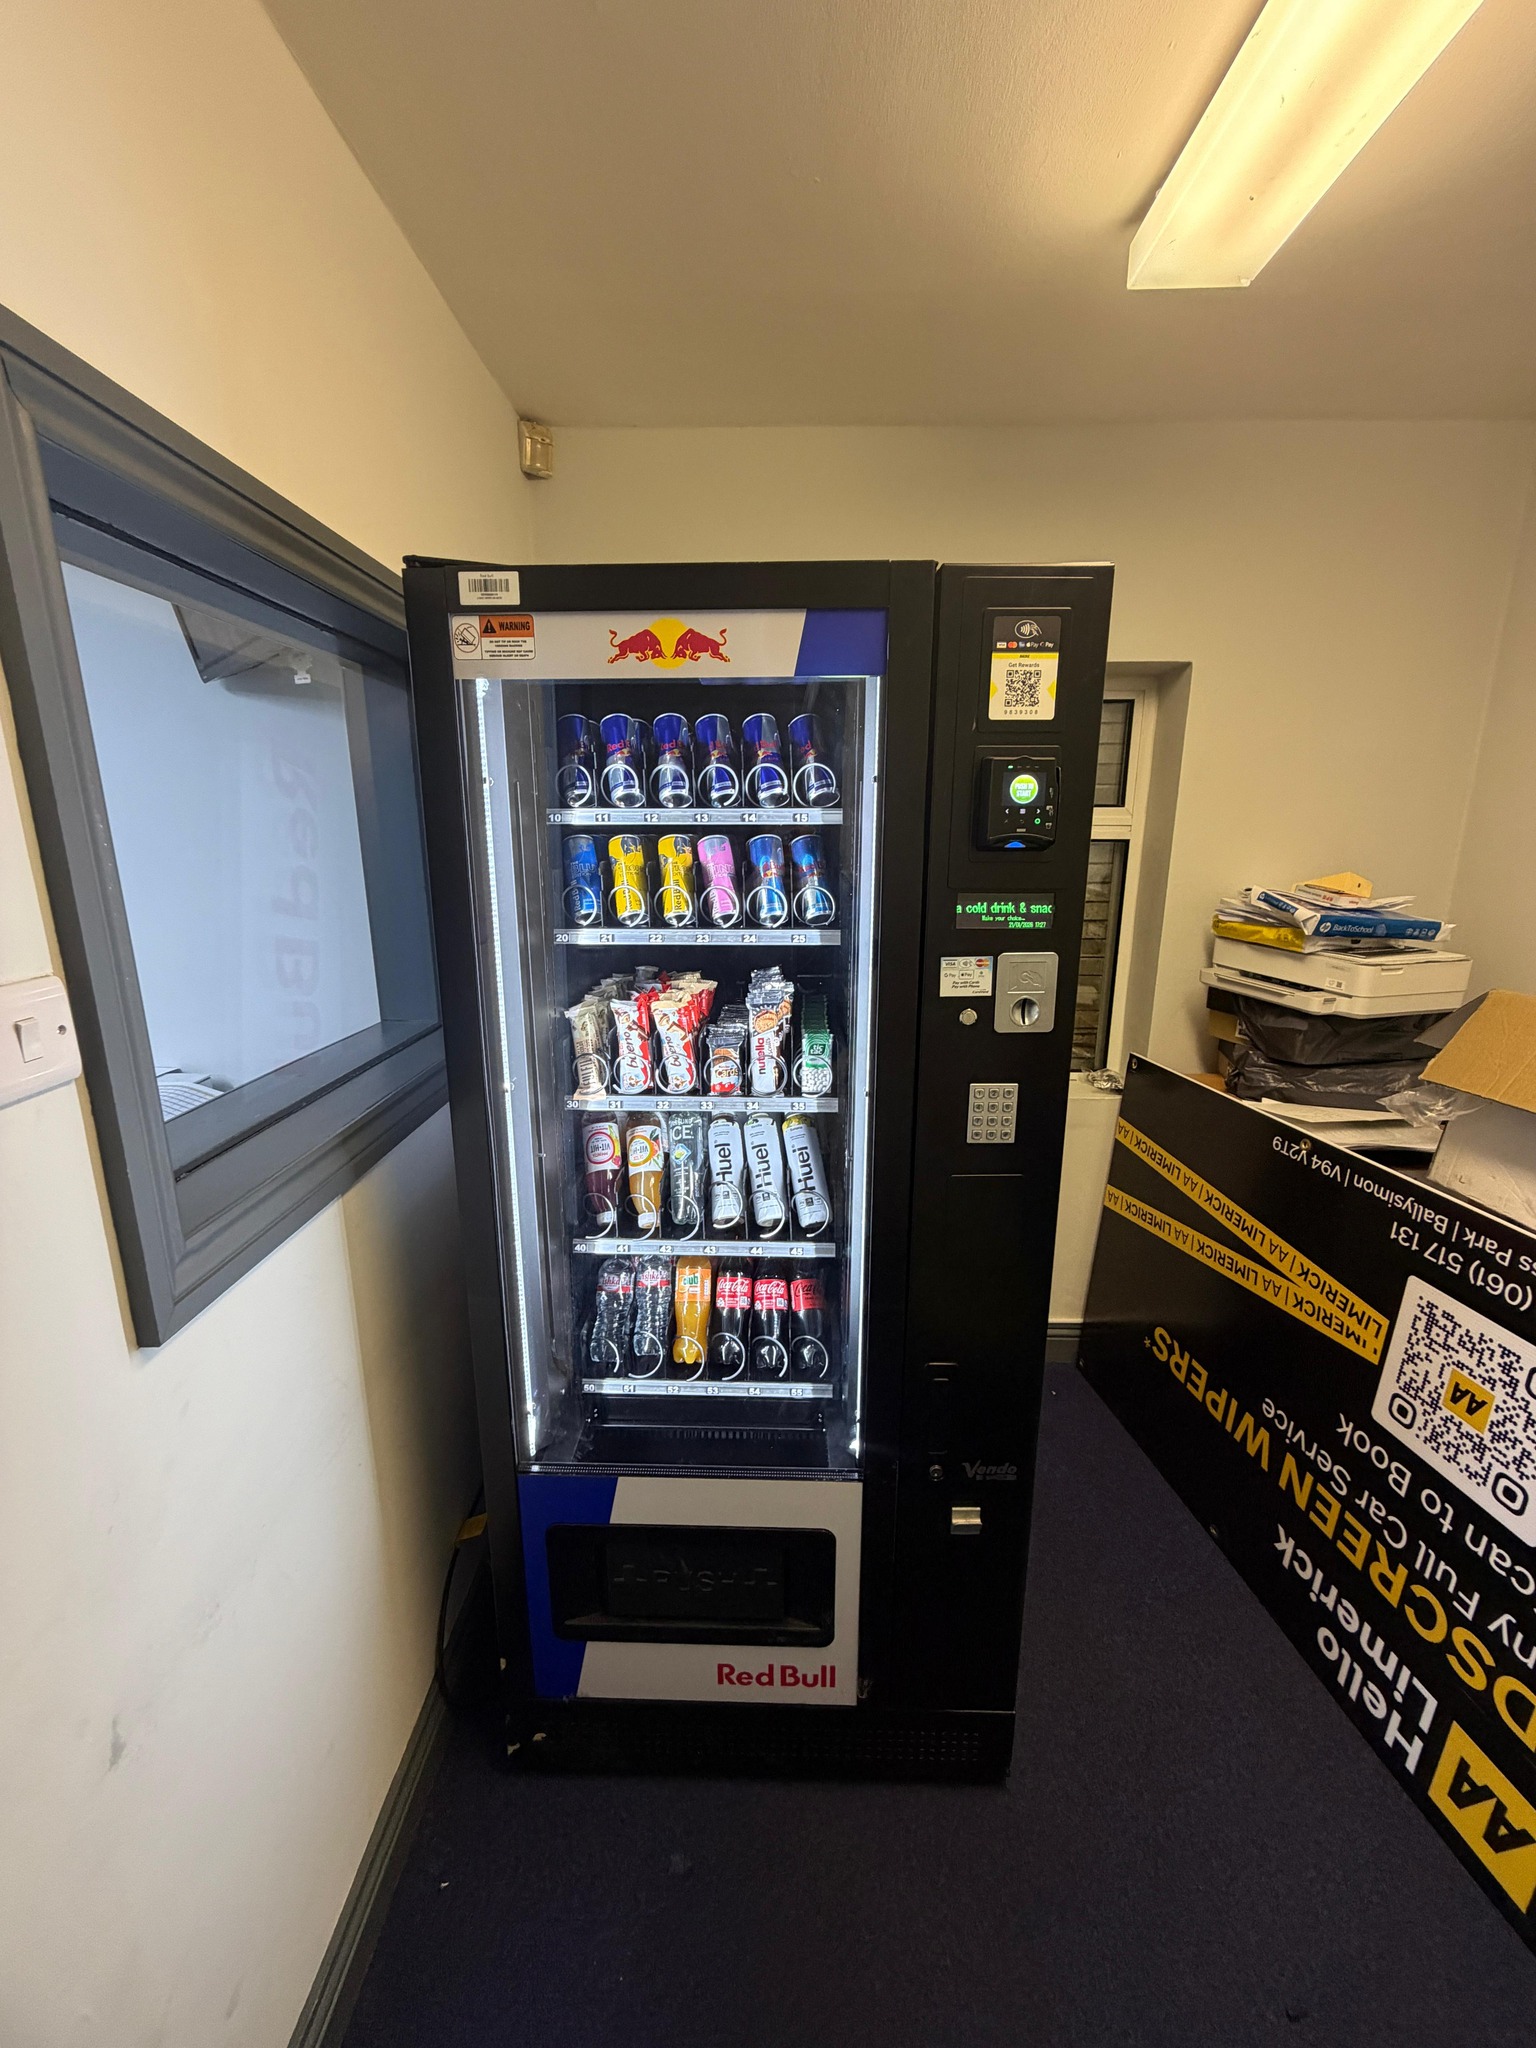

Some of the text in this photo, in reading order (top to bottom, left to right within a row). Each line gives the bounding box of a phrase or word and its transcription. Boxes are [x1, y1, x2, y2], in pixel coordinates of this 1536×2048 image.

[499, 621, 530, 631] WARNING
[549, 814, 561, 822] 10
[596, 814, 608, 822] 11
[645, 814, 658, 822] 12
[696, 814, 708, 822] 13
[743, 814, 756, 822] 14
[795, 814, 808, 822] 15
[674, 895, 682, 911] Red
[966, 902, 987, 913] cold
[990, 902, 1015, 913] drink
[1020, 902, 1026, 913] &
[556, 934, 568, 942] 20
[601, 934, 612, 942] 21
[650, 934, 662, 942] 22
[696, 934, 710, 942] 23
[744, 934, 756, 942] 24
[792, 934, 806, 943] 25
[1332, 923, 1373, 934] BackToSchool
[624, 1031, 639, 1068] bueno
[755, 1037, 766, 1074] nutella
[747, 1102, 759, 1110] 34
[792, 1102, 804, 1110] 35
[1134, 1138, 1181, 1181] LIMERICK
[1272, 1136, 1308, 1165] V2T9
[715, 1143, 732, 1185] Huel
[751, 1143, 773, 1188] Huel
[792, 1146, 816, 1191] Huel
[1311, 1159, 1344, 1187] V94
[1183, 1172, 1198, 1192] AA
[1107, 1190, 1119, 1206] AA
[1354, 1174, 1449, 1234] Ballysimon
[1124, 1201, 1172, 1236] LIMERICK
[1204, 1189, 1266, 1247] LIMERICK
[1175, 1227, 1189, 1245] AA
[1463, 1227, 1512, 1267] Park
[574, 1244, 586, 1252] 40
[704, 1246, 716, 1254] 43
[751, 1247, 763, 1255] 44
[791, 1247, 802, 1255] 45
[1269, 1238, 1289, 1263] AA
[1197, 1239, 1258, 1285] LIMERICK
[1389, 1221, 1533, 1312] (061) 517 131
[1262, 1275, 1282, 1297] AA
[1297, 1262, 1383, 1339] LIMERICK
[790, 1388, 802, 1396] 55
[1450, 1381, 1488, 1416] AA
[1262, 1398, 1351, 1496] Service
[1336, 1413, 1412, 1498] Book
[1355, 1490, 1408, 1549] Car
[1420, 1488, 1453, 1534] to
[1414, 1540, 1480, 1621] Full
[1274, 1523, 1438, 1734] Limerick
[717, 1663, 836, 1688] Red Bull
[1317, 1627, 1424, 1775] Hello
[1447, 1756, 1536, 1854] AA
